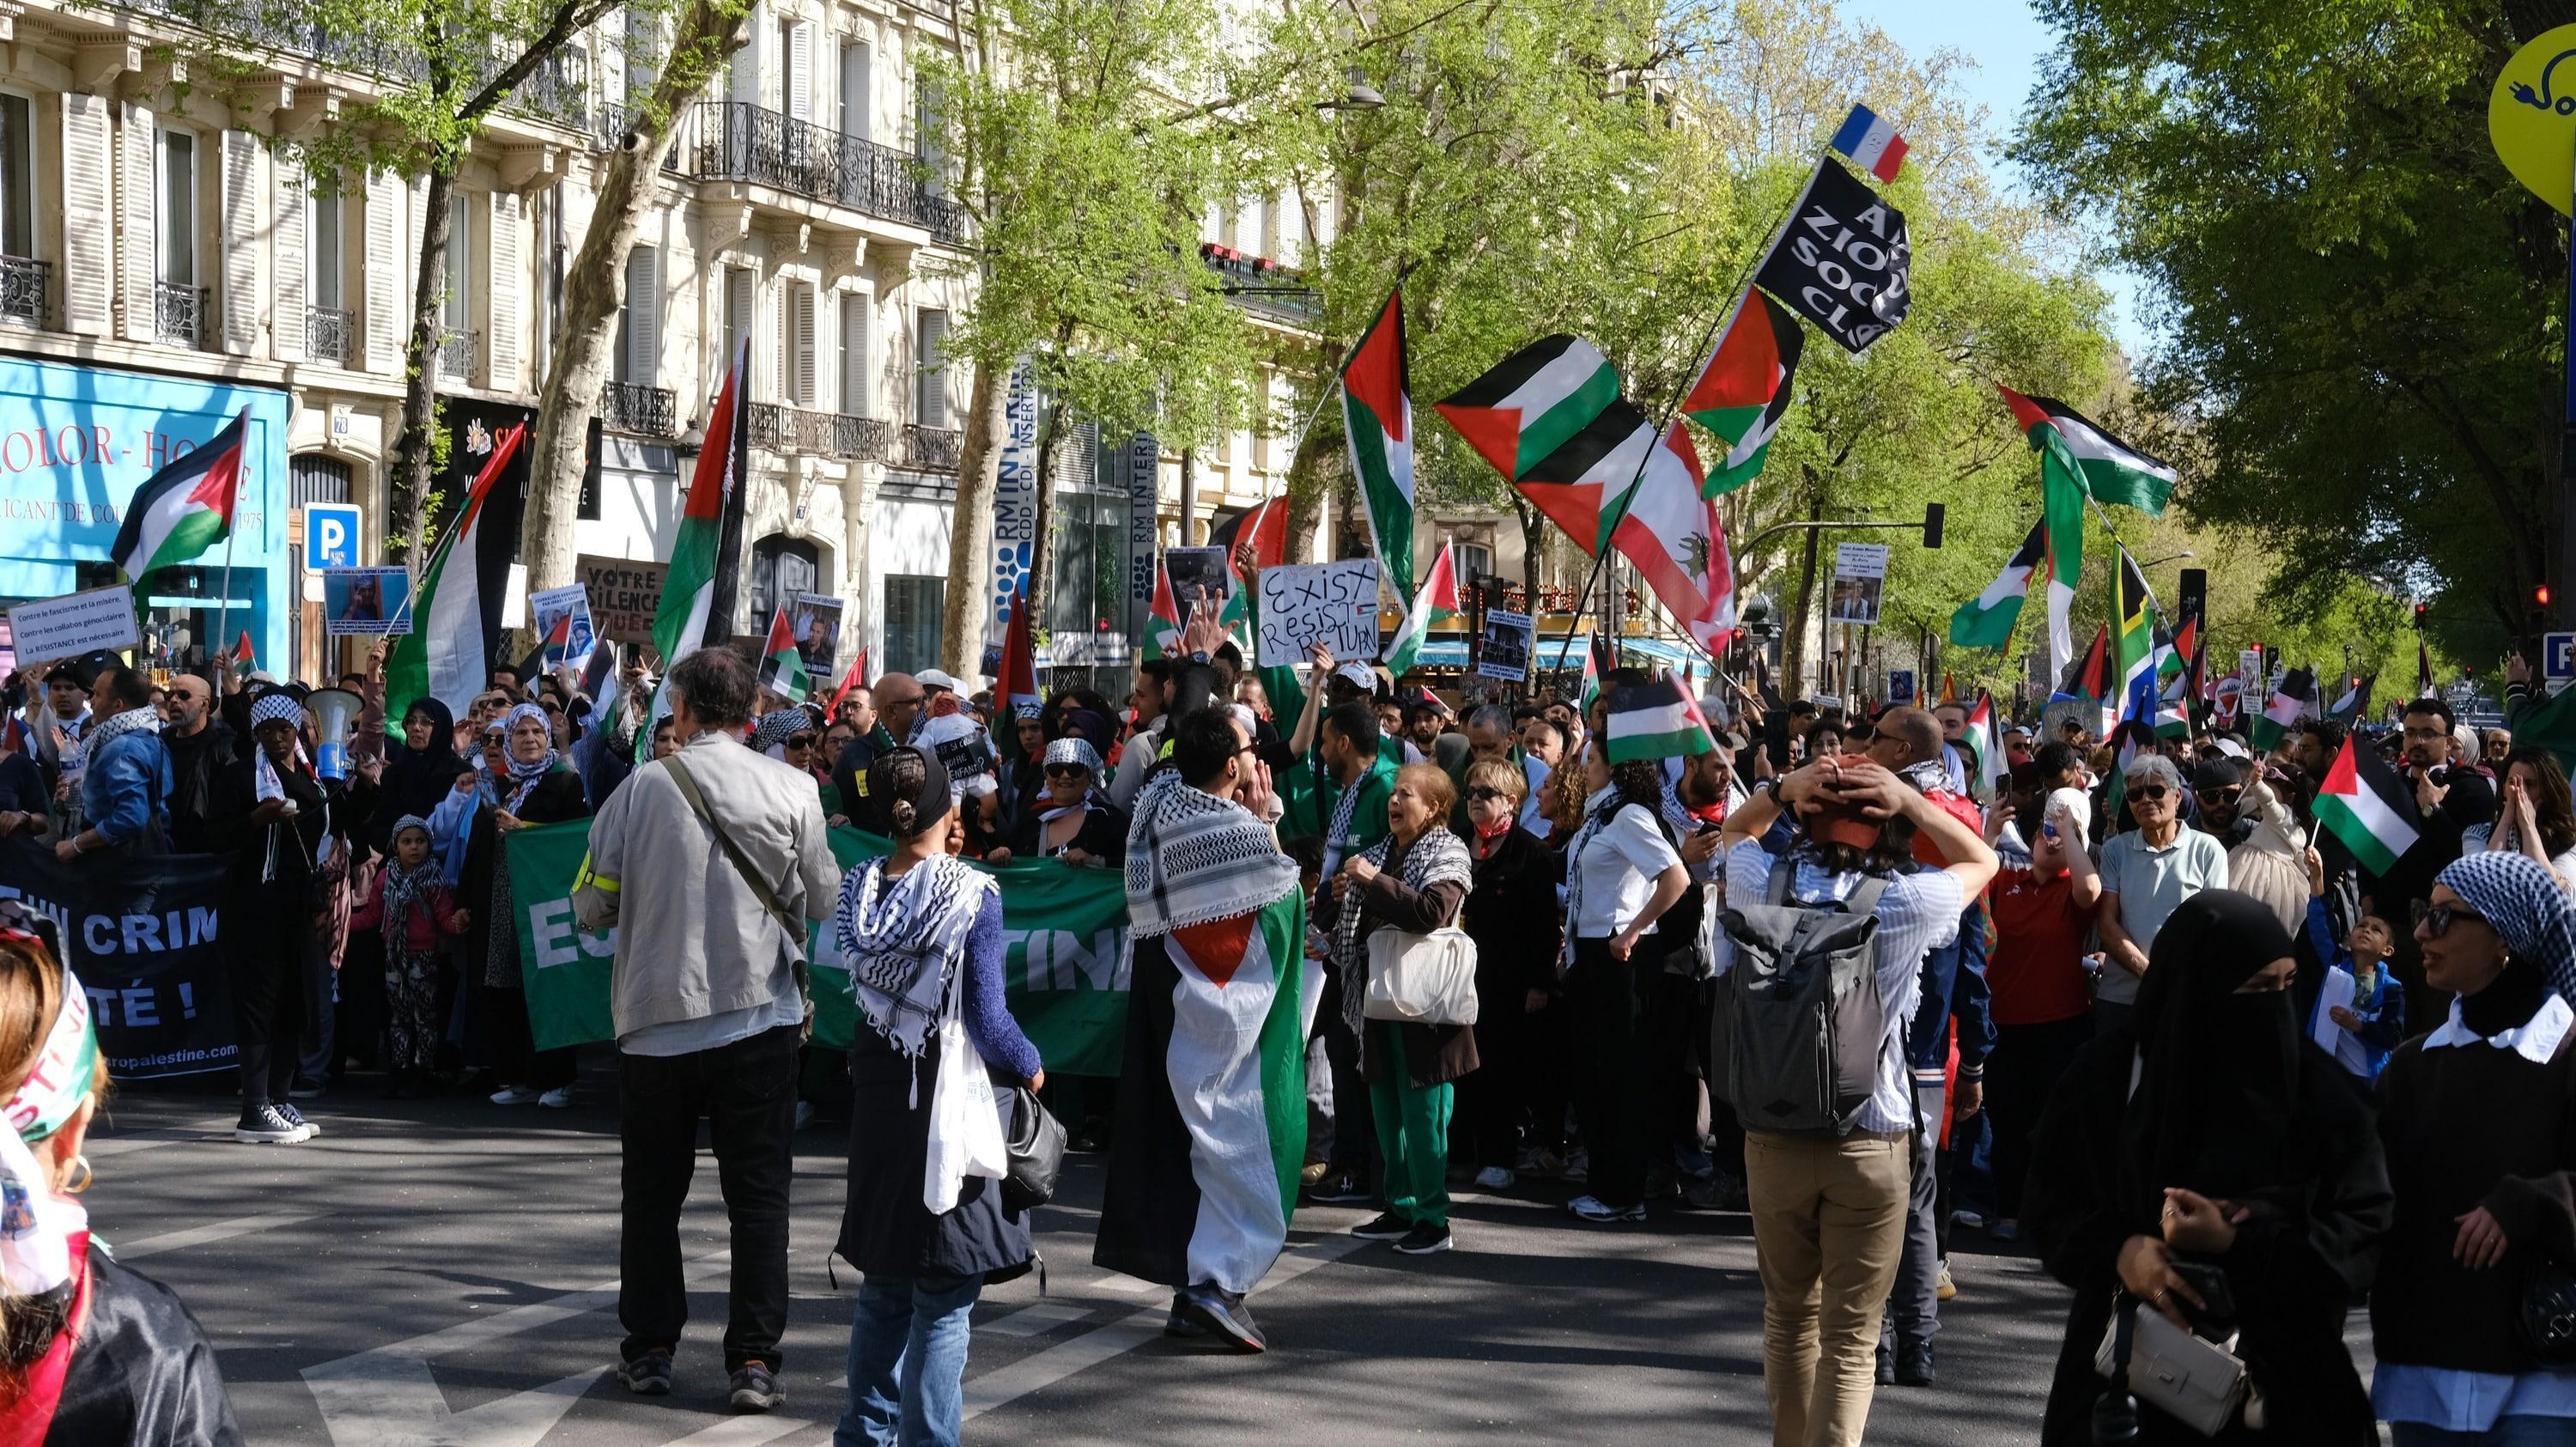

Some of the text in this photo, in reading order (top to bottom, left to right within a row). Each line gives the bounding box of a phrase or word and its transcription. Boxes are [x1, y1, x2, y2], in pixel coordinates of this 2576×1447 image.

[336, 417, 348, 434] 78
[0, 425, 113, 473] OLOR
[1020, 465, 1032, 487] CDI
[0, 498, 60, 520] ICANT
[64, 502, 87, 523] DE
[238, 512, 263, 530] 1975
[996, 500, 1018, 540] RM
[1019, 507, 1031, 540] CDD
[321, 519, 345, 560] P
[1133, 516, 1147, 543] RM
[587, 564, 656, 589] VOTRE
[18, 612, 41, 623] Contre
[49, 605, 79, 617] fascisme
[20, 612, 126, 639] Contre les collabos génocidaires
[35, 638, 76, 653] RÉSISTANCE
[88, 629, 125, 642] nécessaire
[945, 752, 967, 768] VOTRE
[949, 763, 977, 781] ENFANT
[83, 906, 217, 955] CRIM
